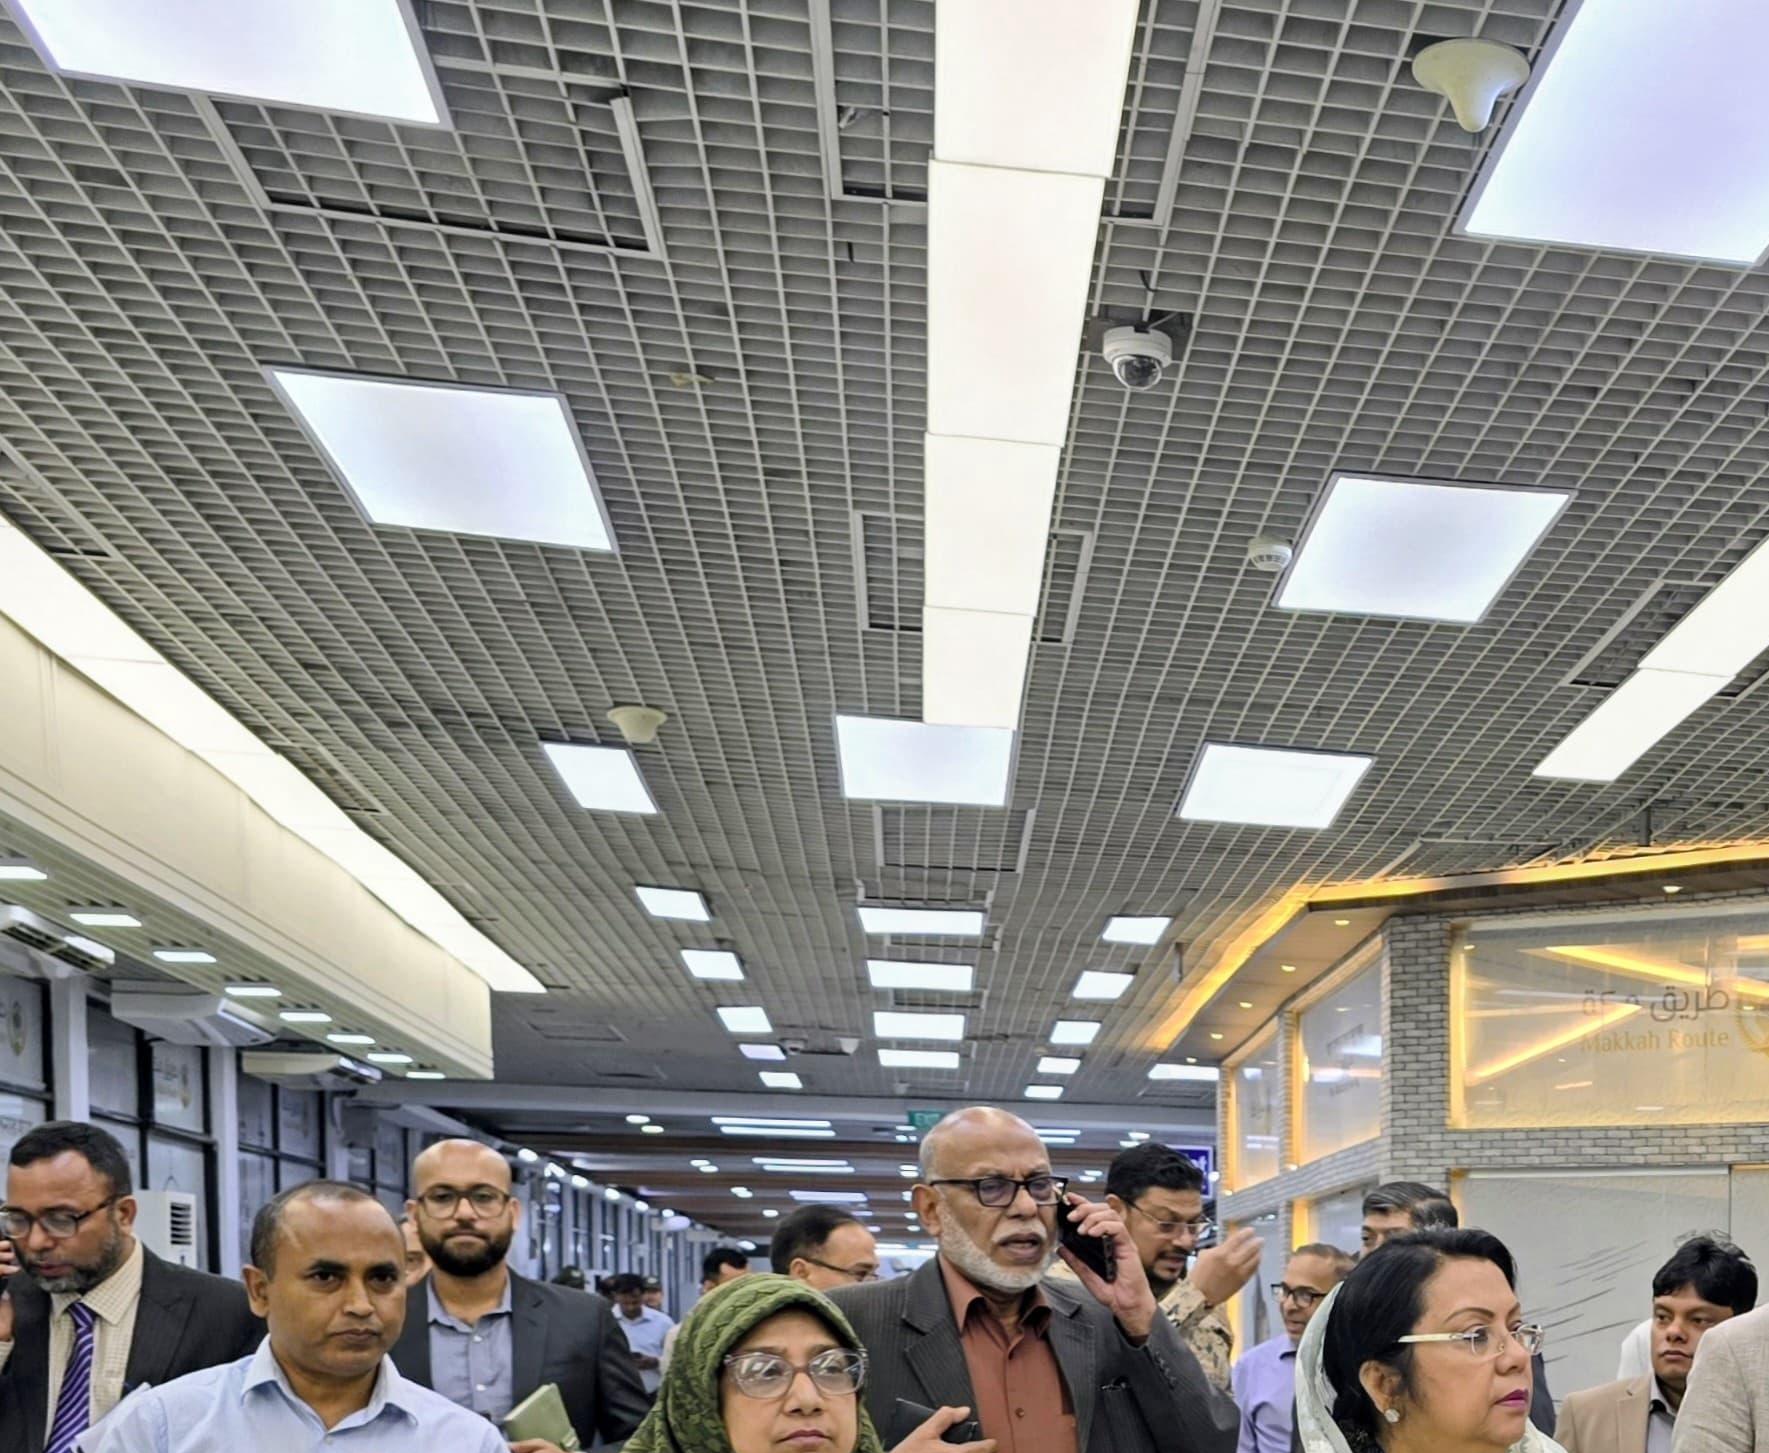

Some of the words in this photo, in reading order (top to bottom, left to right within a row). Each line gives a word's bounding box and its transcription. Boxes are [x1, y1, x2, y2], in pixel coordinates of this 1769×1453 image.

[1650, 985, 1730, 1023] طريق
[1580, 1030, 1660, 1053] Makkah
[1668, 1028, 1729, 1049] Route
